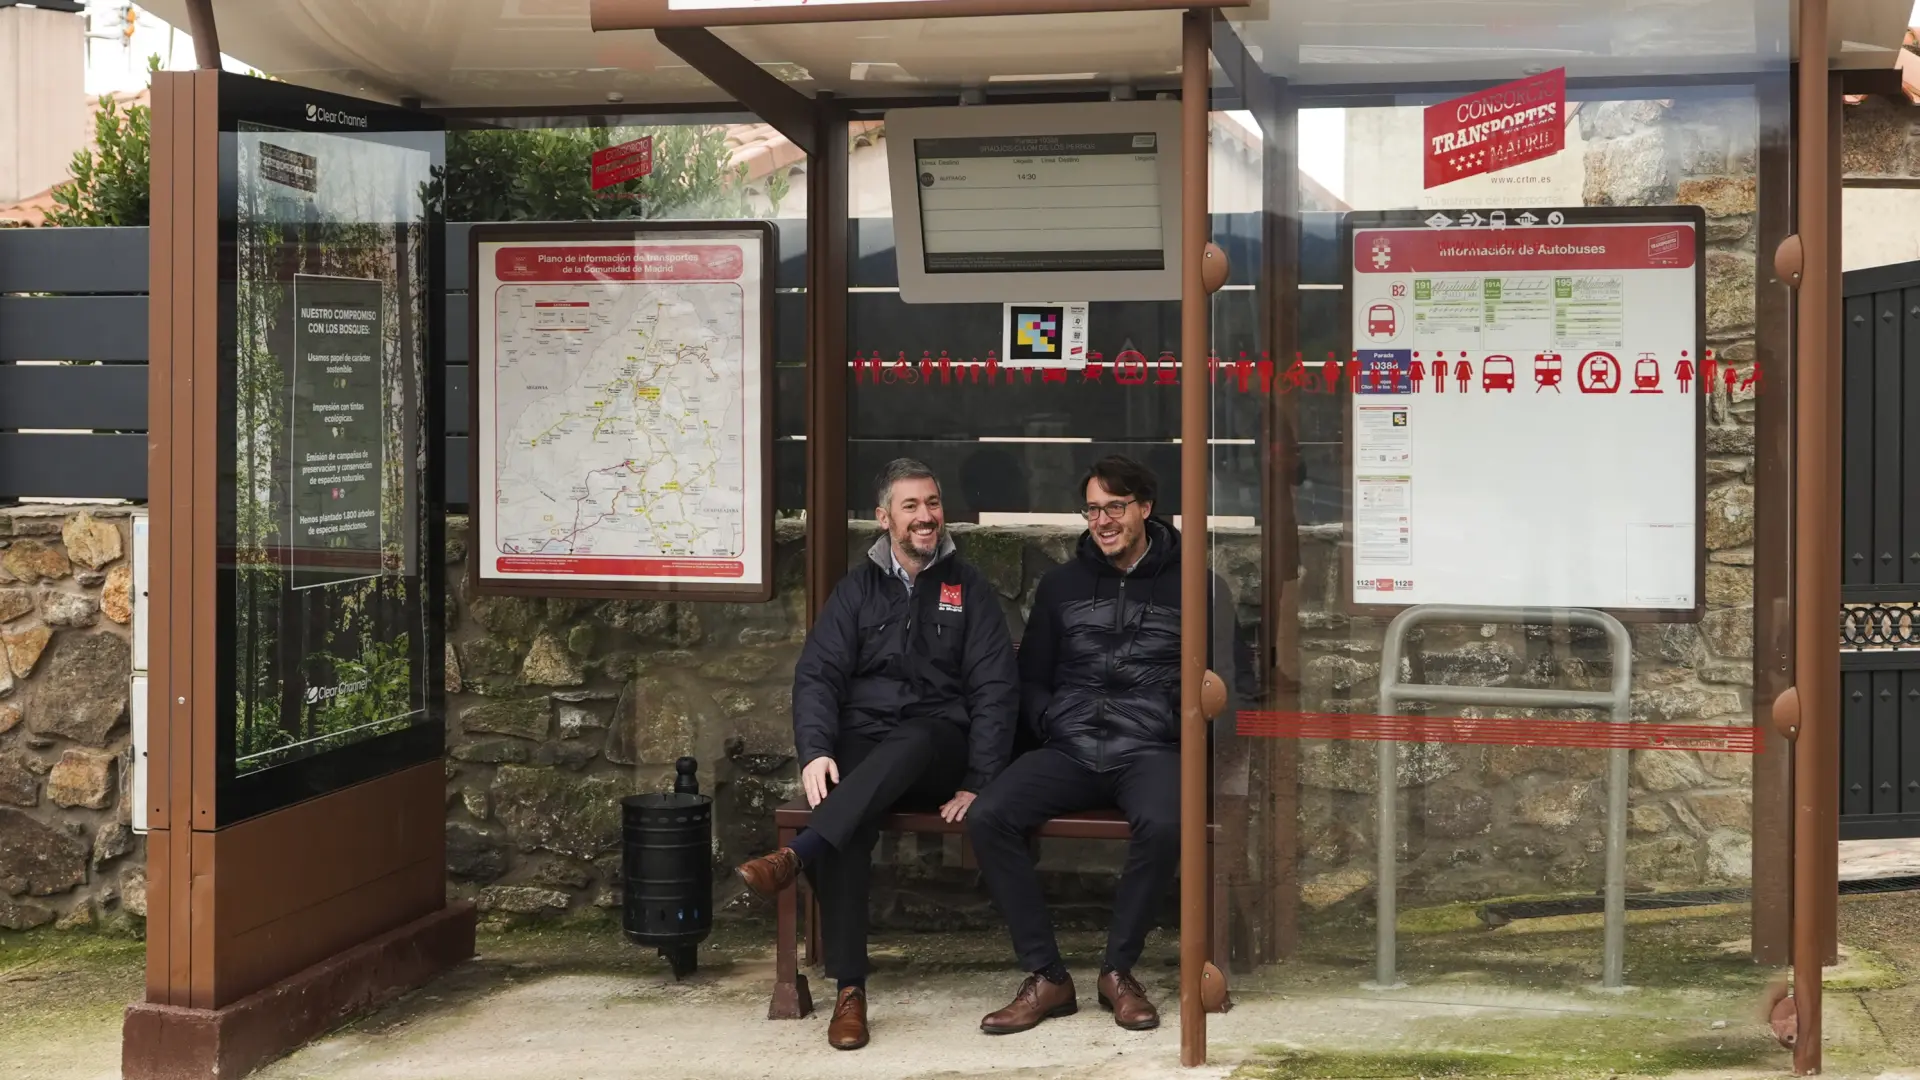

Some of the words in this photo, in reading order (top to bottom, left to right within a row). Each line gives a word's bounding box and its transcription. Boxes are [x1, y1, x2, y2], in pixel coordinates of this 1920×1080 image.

[318, 108, 337, 123] Clear
[338, 111, 368, 127] Channel
[1432, 101, 1557, 156] TRANSPORTES
[1491, 175, 1551, 184] www.crtm.es
[1440, 244, 1515, 257] Información
[1518, 244, 1534, 255] de
[1537, 243, 1606, 255] Autobuses
[538, 254, 562, 263] Plano
[565, 254, 577, 262] de
[578, 253, 631, 263] información
[633, 253, 645, 262] de
[646, 253, 698, 264] transportes
[562, 265, 573, 274] de
[574, 265, 582, 273] la
[583, 265, 631, 274] Comunidad
[632, 265, 642, 273] de
[644, 264, 674, 273] Madrid
[1415, 281, 1430, 289] 191
[1556, 279, 1572, 287] 195
[1392, 284, 1406, 297] B2
[301, 308, 333, 319] NUESTRO
[334, 309, 377, 321] COMPROMISO
[308, 323, 324, 333] CON
[325, 324, 338, 334] LOS
[308, 353, 330, 362] Usamos
[312, 403, 340, 414] Impresión
[306, 453, 328, 462] Emisión
[328, 452, 336, 460] de
[309, 477, 317, 485] de
[317, 475, 341, 485] espacios
[300, 516, 319, 524] Hemos
[319, 513, 342, 524] plantado
[308, 527, 315, 535] de
[316, 525, 338, 535] especies
[318, 686, 338, 700] Clear
[339, 678, 368, 694] Channel
